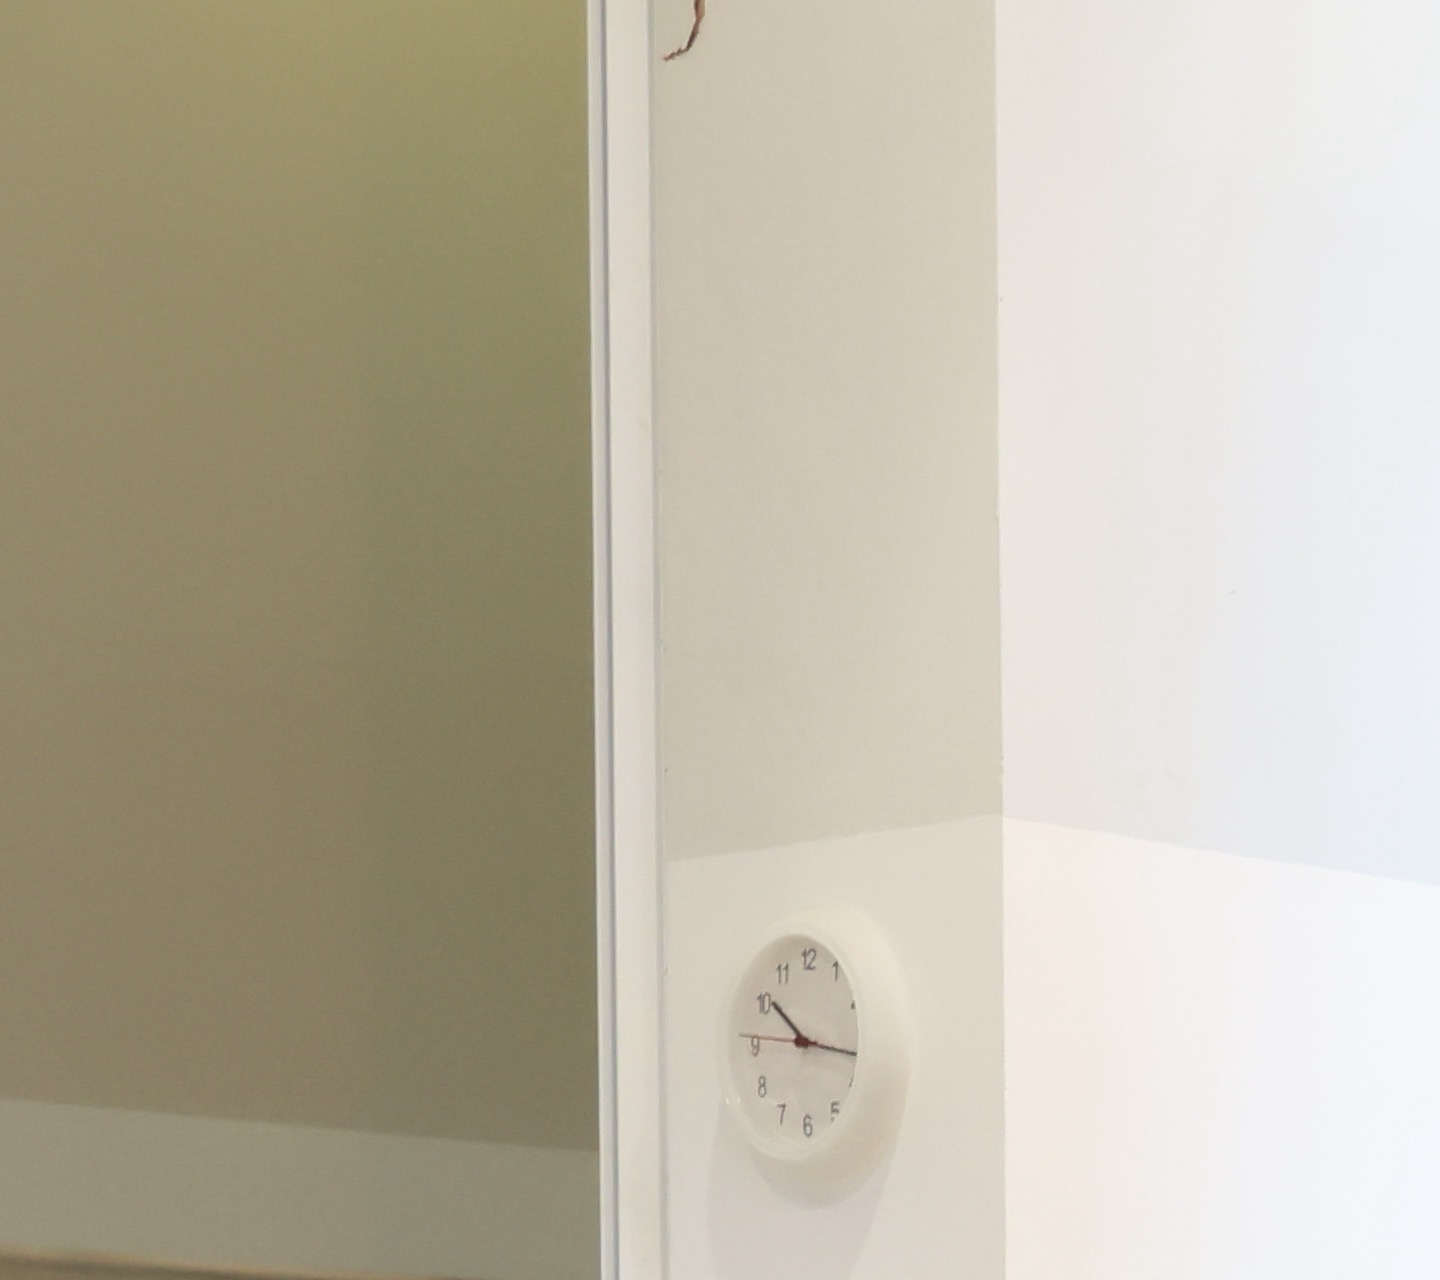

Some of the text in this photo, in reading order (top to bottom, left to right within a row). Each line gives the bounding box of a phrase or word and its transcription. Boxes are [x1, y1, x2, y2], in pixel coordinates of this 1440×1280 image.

[801, 948, 817, 971] 12
[776, 963, 789, 984] 11
[757, 992, 771, 1015] 10
[751, 1035, 760, 1057] 9
[758, 1075, 767, 1098] 8
[777, 1103, 786, 1126] 7
[803, 1114, 813, 1137] 6
